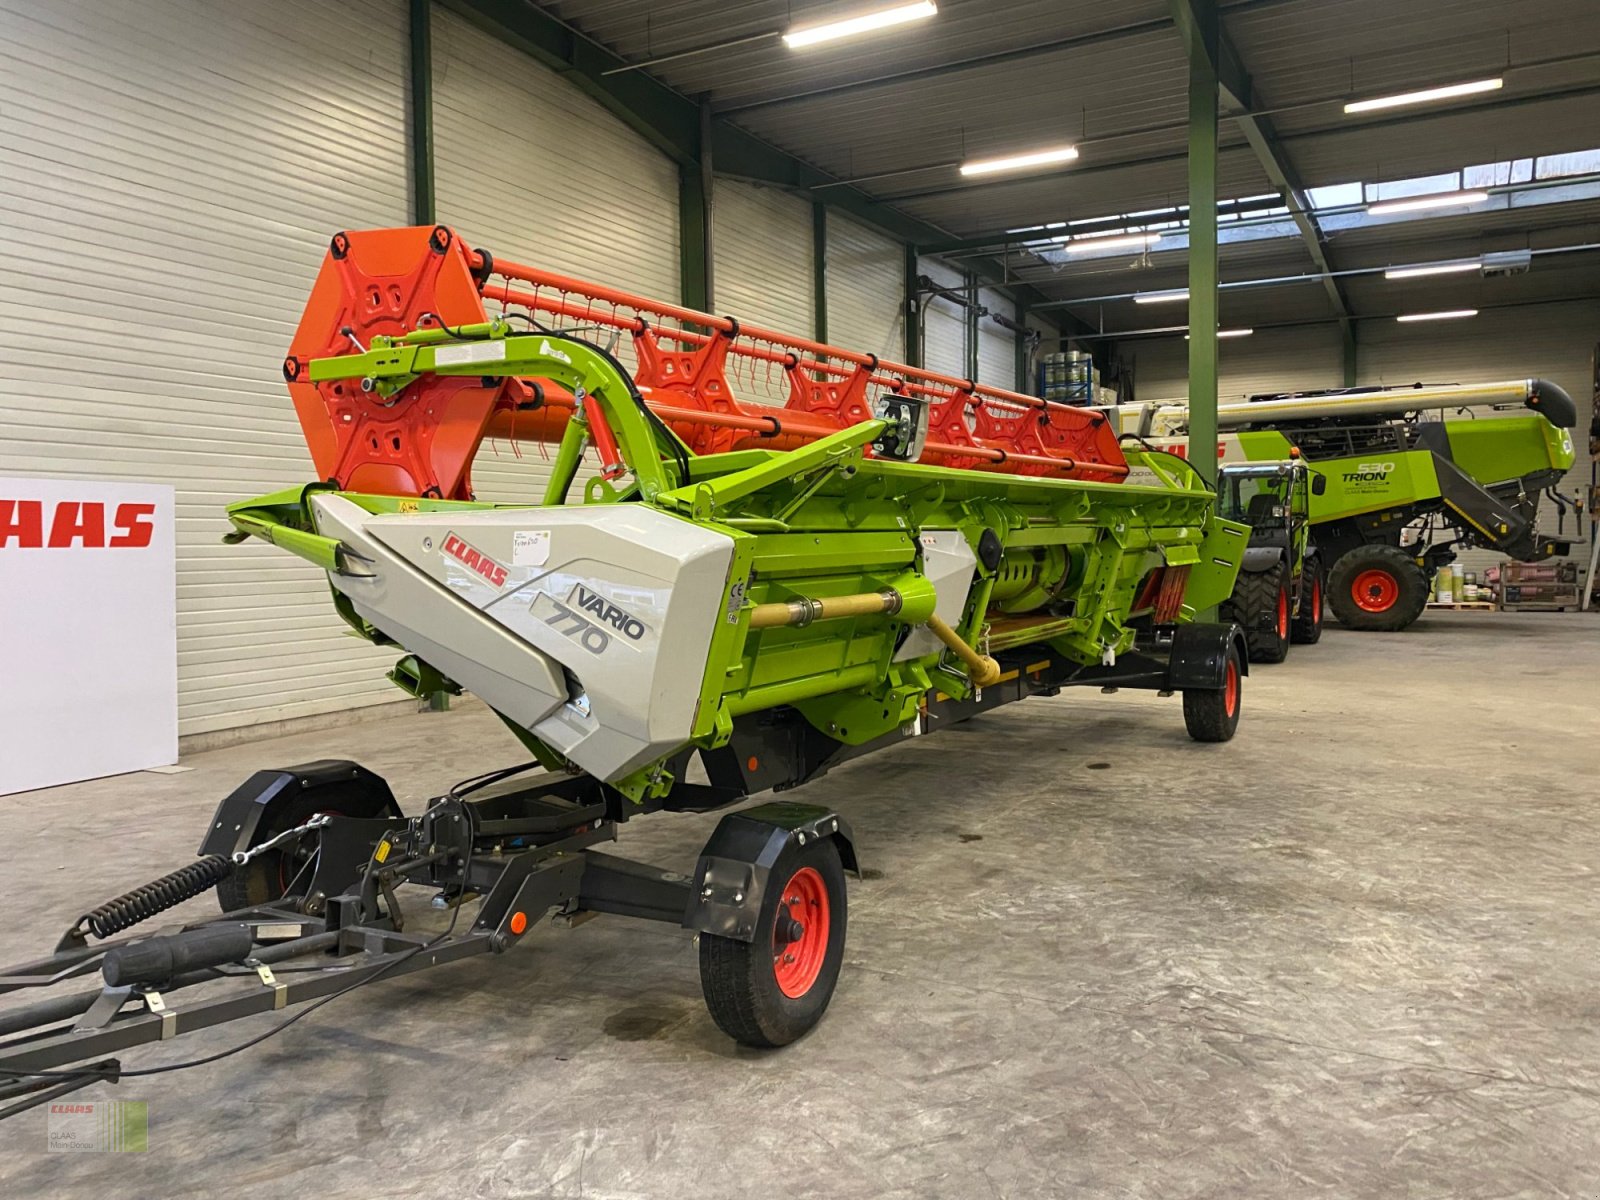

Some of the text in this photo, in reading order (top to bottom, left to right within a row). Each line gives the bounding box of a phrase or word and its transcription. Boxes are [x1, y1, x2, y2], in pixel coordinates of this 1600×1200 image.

[1342, 472, 1387, 482] TRION
[1357, 462, 1395, 474] 530
[445, 536, 508, 587] CLAAS
[544, 602, 609, 654] 770
[578, 587, 645, 640] VARIO
